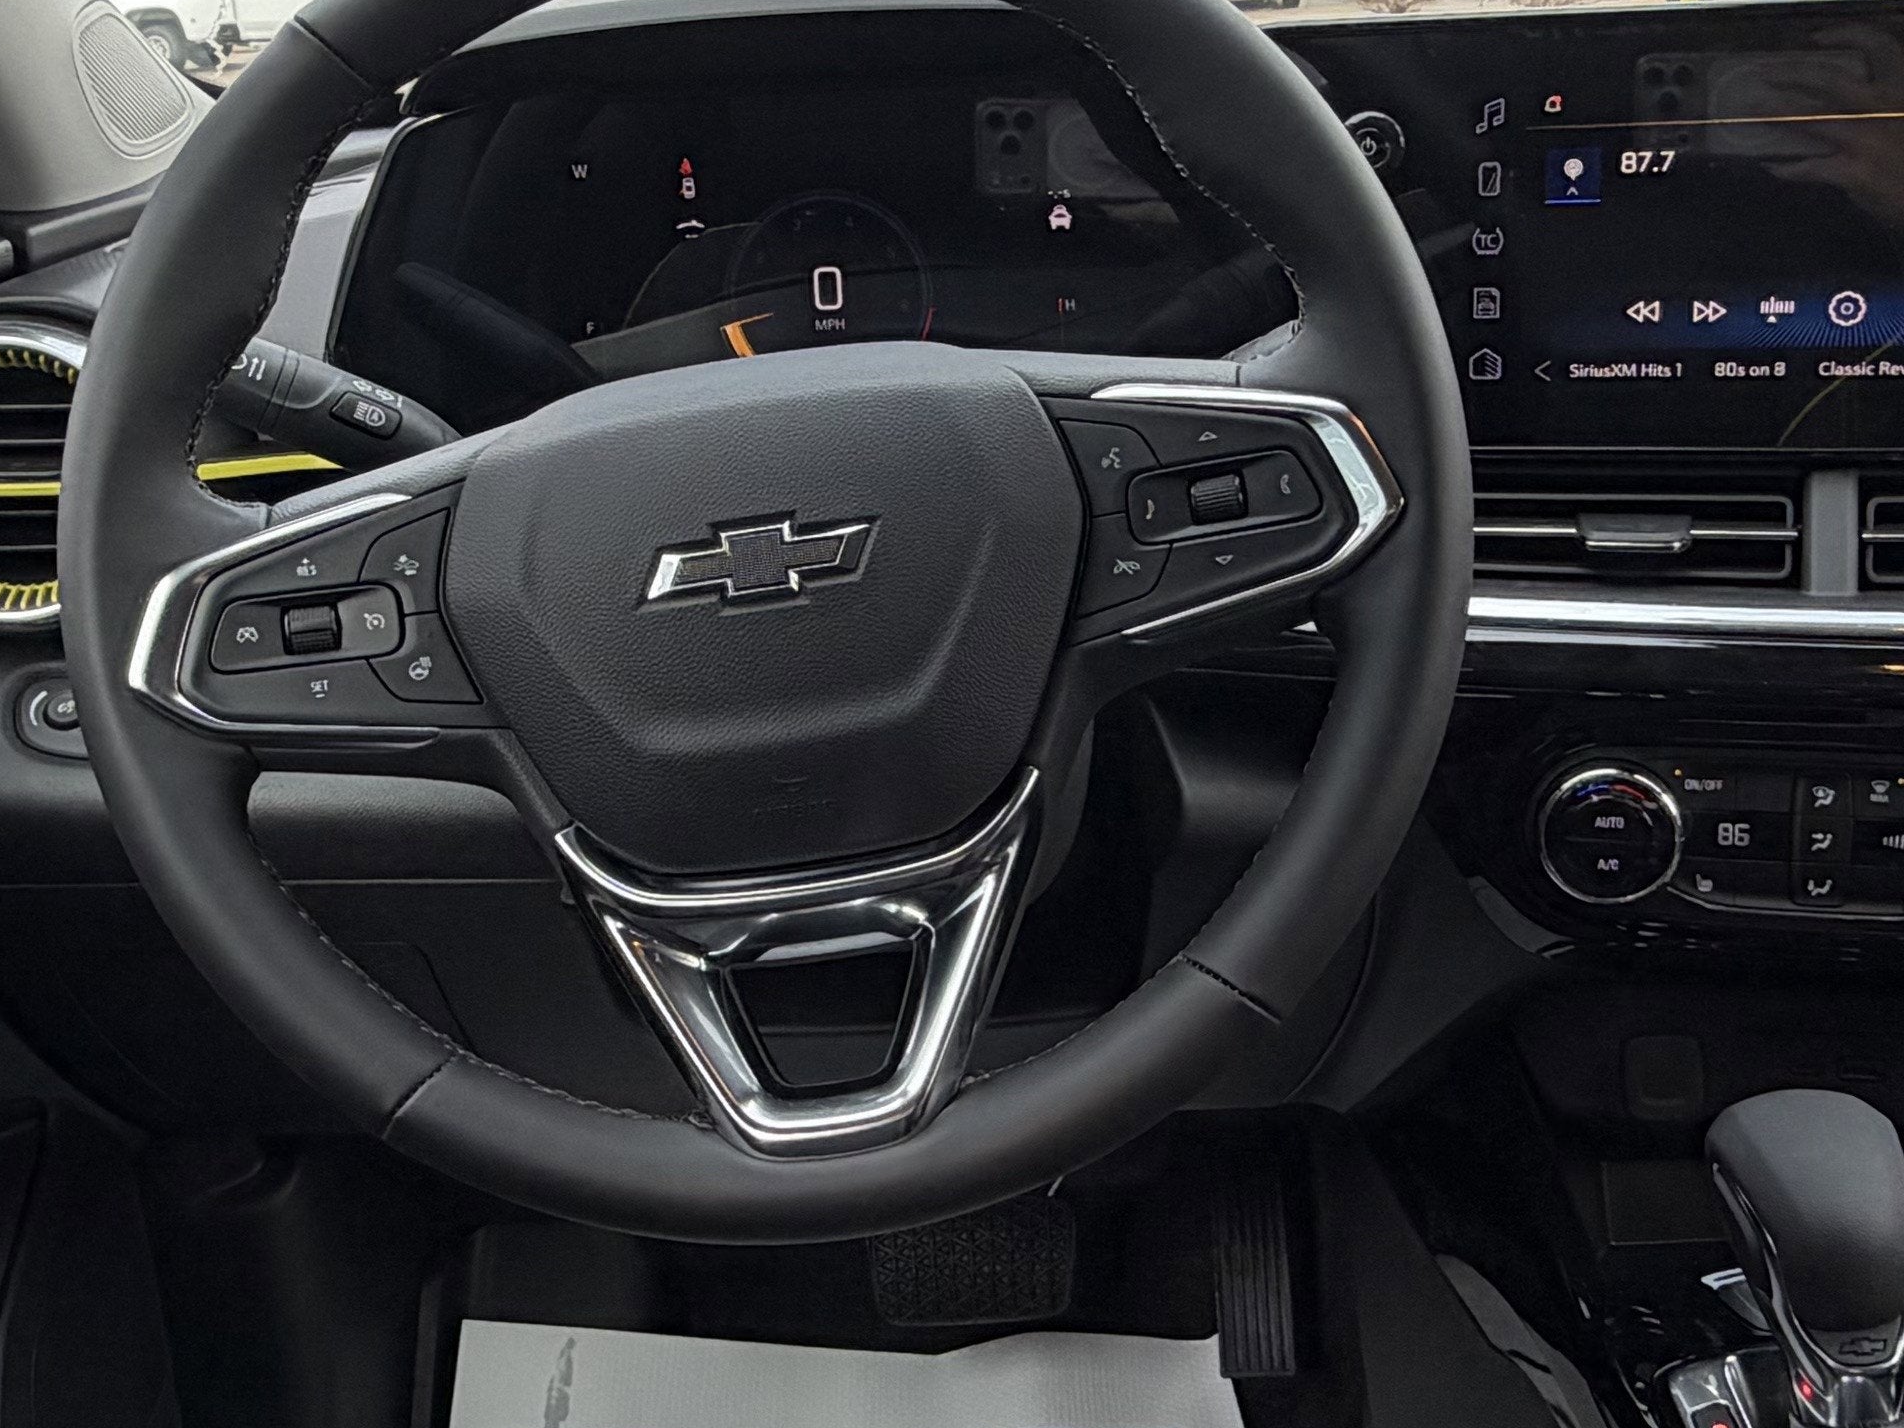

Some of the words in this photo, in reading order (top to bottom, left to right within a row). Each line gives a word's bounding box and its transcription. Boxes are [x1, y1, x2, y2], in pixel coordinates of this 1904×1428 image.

[1620, 150, 1676, 174] 87.7
[571, 164, 588, 179] W
[812, 266, 844, 311] 0
[1064, 297, 1076, 312] H
[814, 317, 846, 331] MPH
[1568, 362, 1638, 378] SiriusXM
[1639, 362, 1673, 378] Hits
[1674, 362, 1683, 378] 1
[1714, 361, 1746, 378] 80s
[1749, 364, 1771, 377] on
[1773, 361, 1787, 377] 8
[1818, 361, 1876, 378] Classic
[1684, 779, 1724, 791] ON/OFF
[1595, 816, 1625, 829] AUTO
[1597, 858, 1619, 872] A/C
